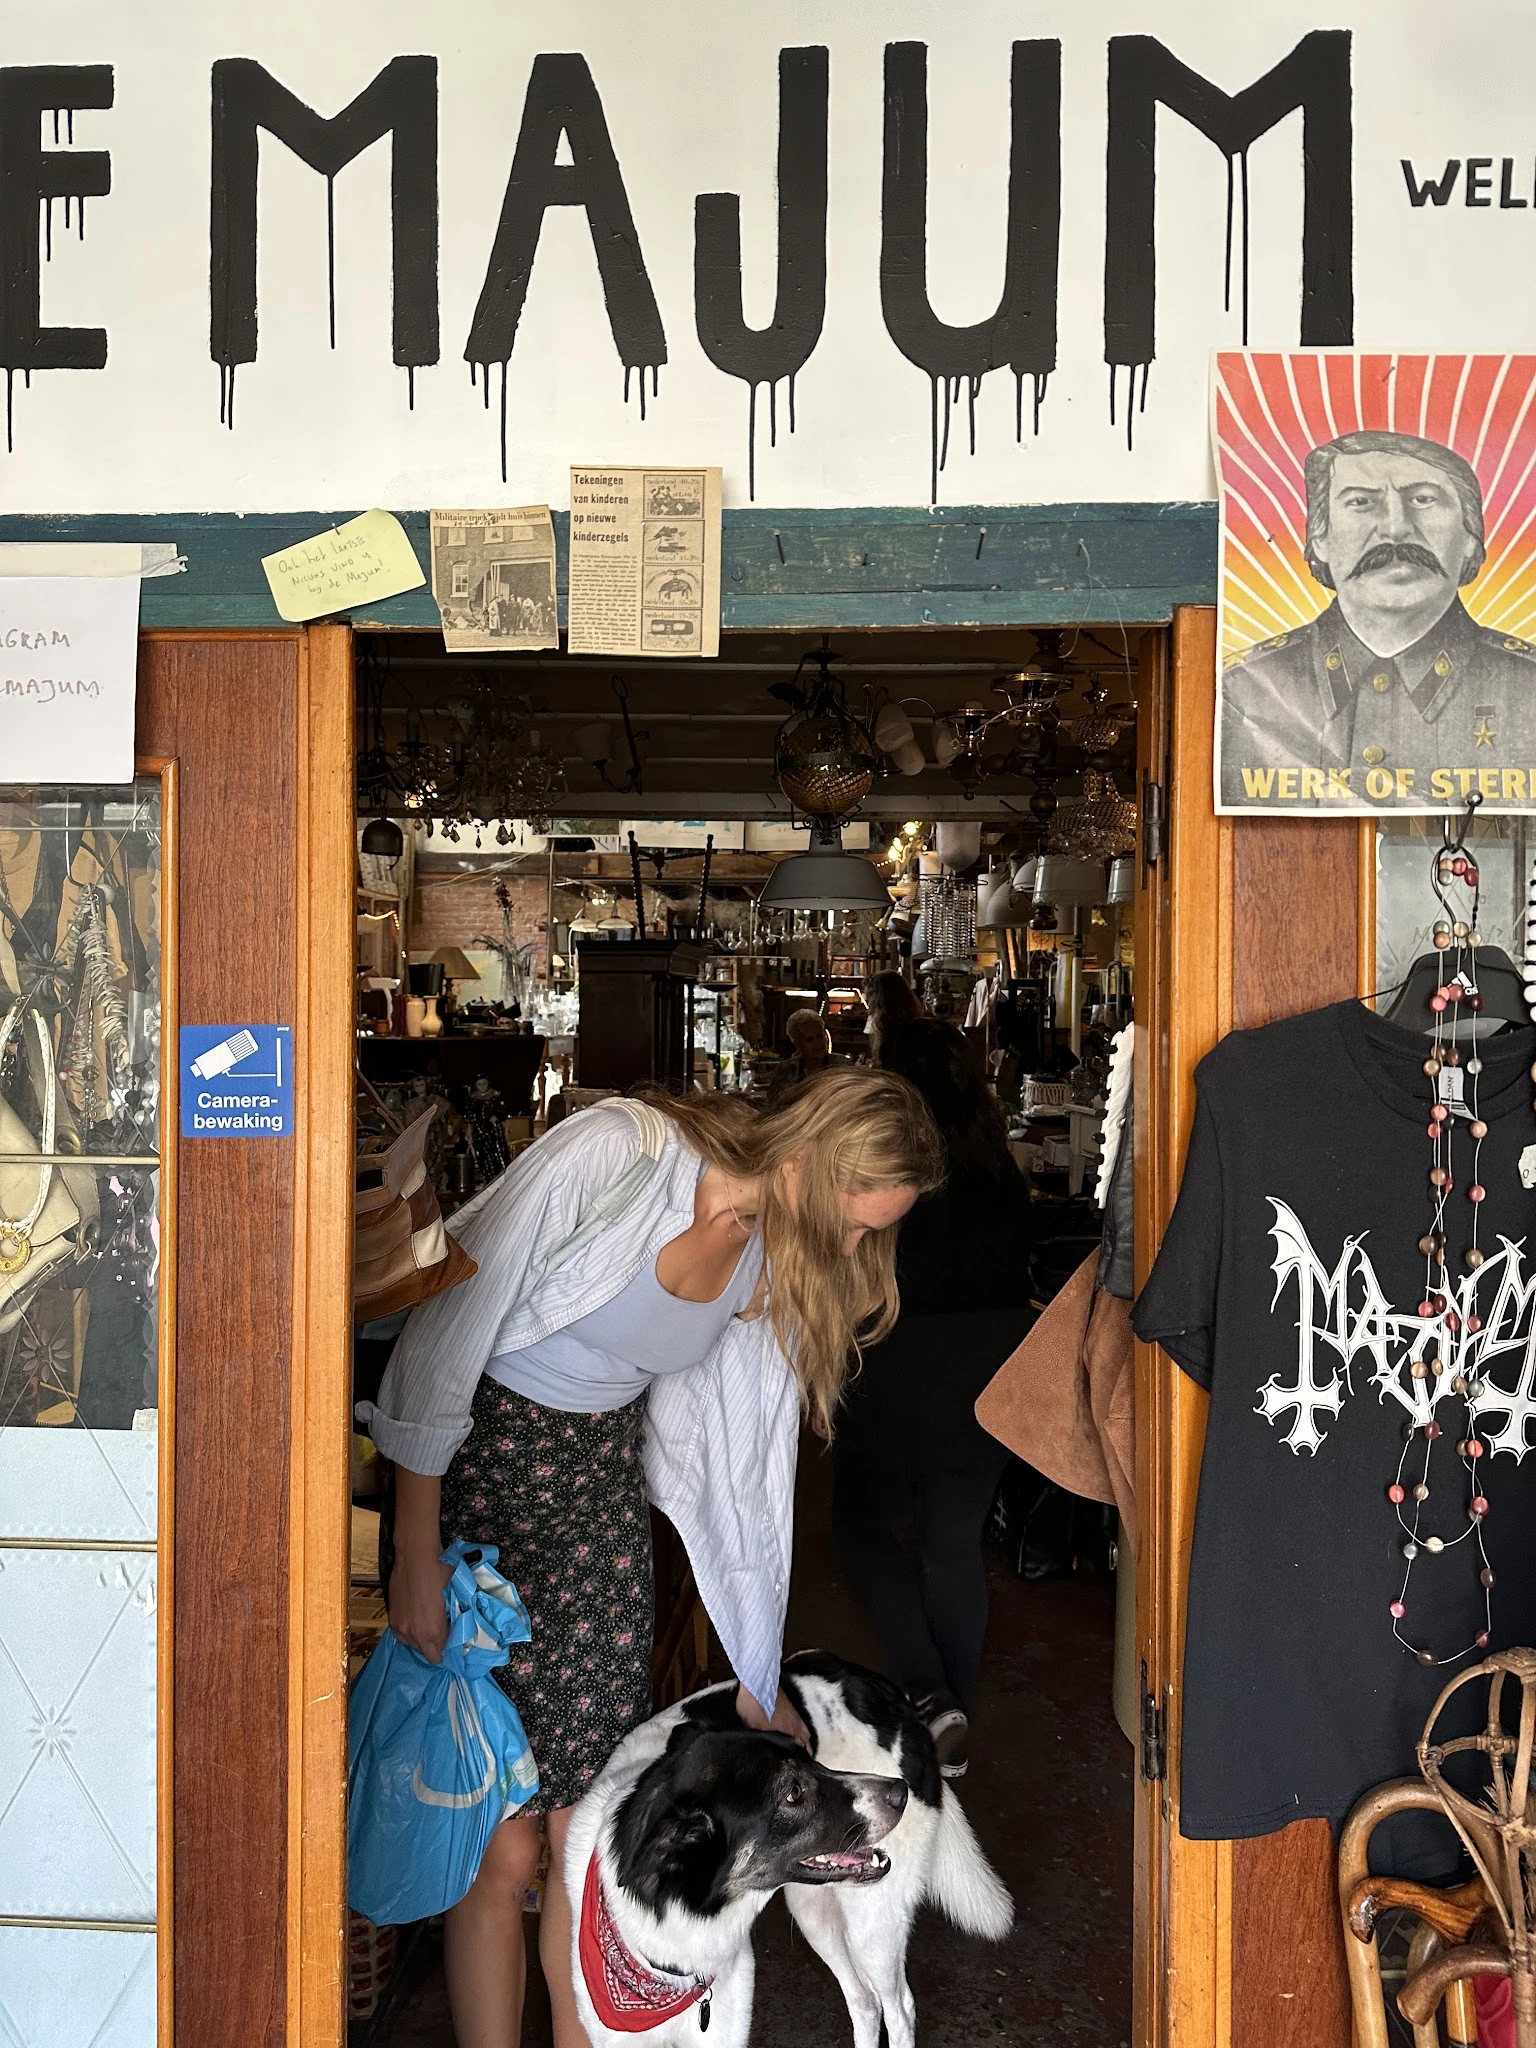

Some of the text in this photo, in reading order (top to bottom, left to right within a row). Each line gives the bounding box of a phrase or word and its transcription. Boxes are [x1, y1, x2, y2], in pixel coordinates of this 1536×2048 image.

[1401, 158, 1536, 208] WEL
[210, 29, 1354, 385] MAJUM
[574, 474, 624, 486] Tekeningen
[573, 494, 629, 505] van kinderen
[434, 512, 468, 521] Militaire
[469, 513, 488, 521] truck
[508, 512, 523, 520] huis
[523, 511, 547, 520] binnen
[573, 514, 617, 524] op nieuwe
[573, 531, 629, 544] kinderzegels
[302, 545, 327, 563] het
[0, 628, 71, 650] GRAM
[0, 679, 100, 704] MAJUM
[1241, 767, 1353, 799] WERK
[1366, 767, 1416, 799] OF
[197, 1092, 279, 1109] Camera-
[193, 1113, 283, 1132] bewaking
